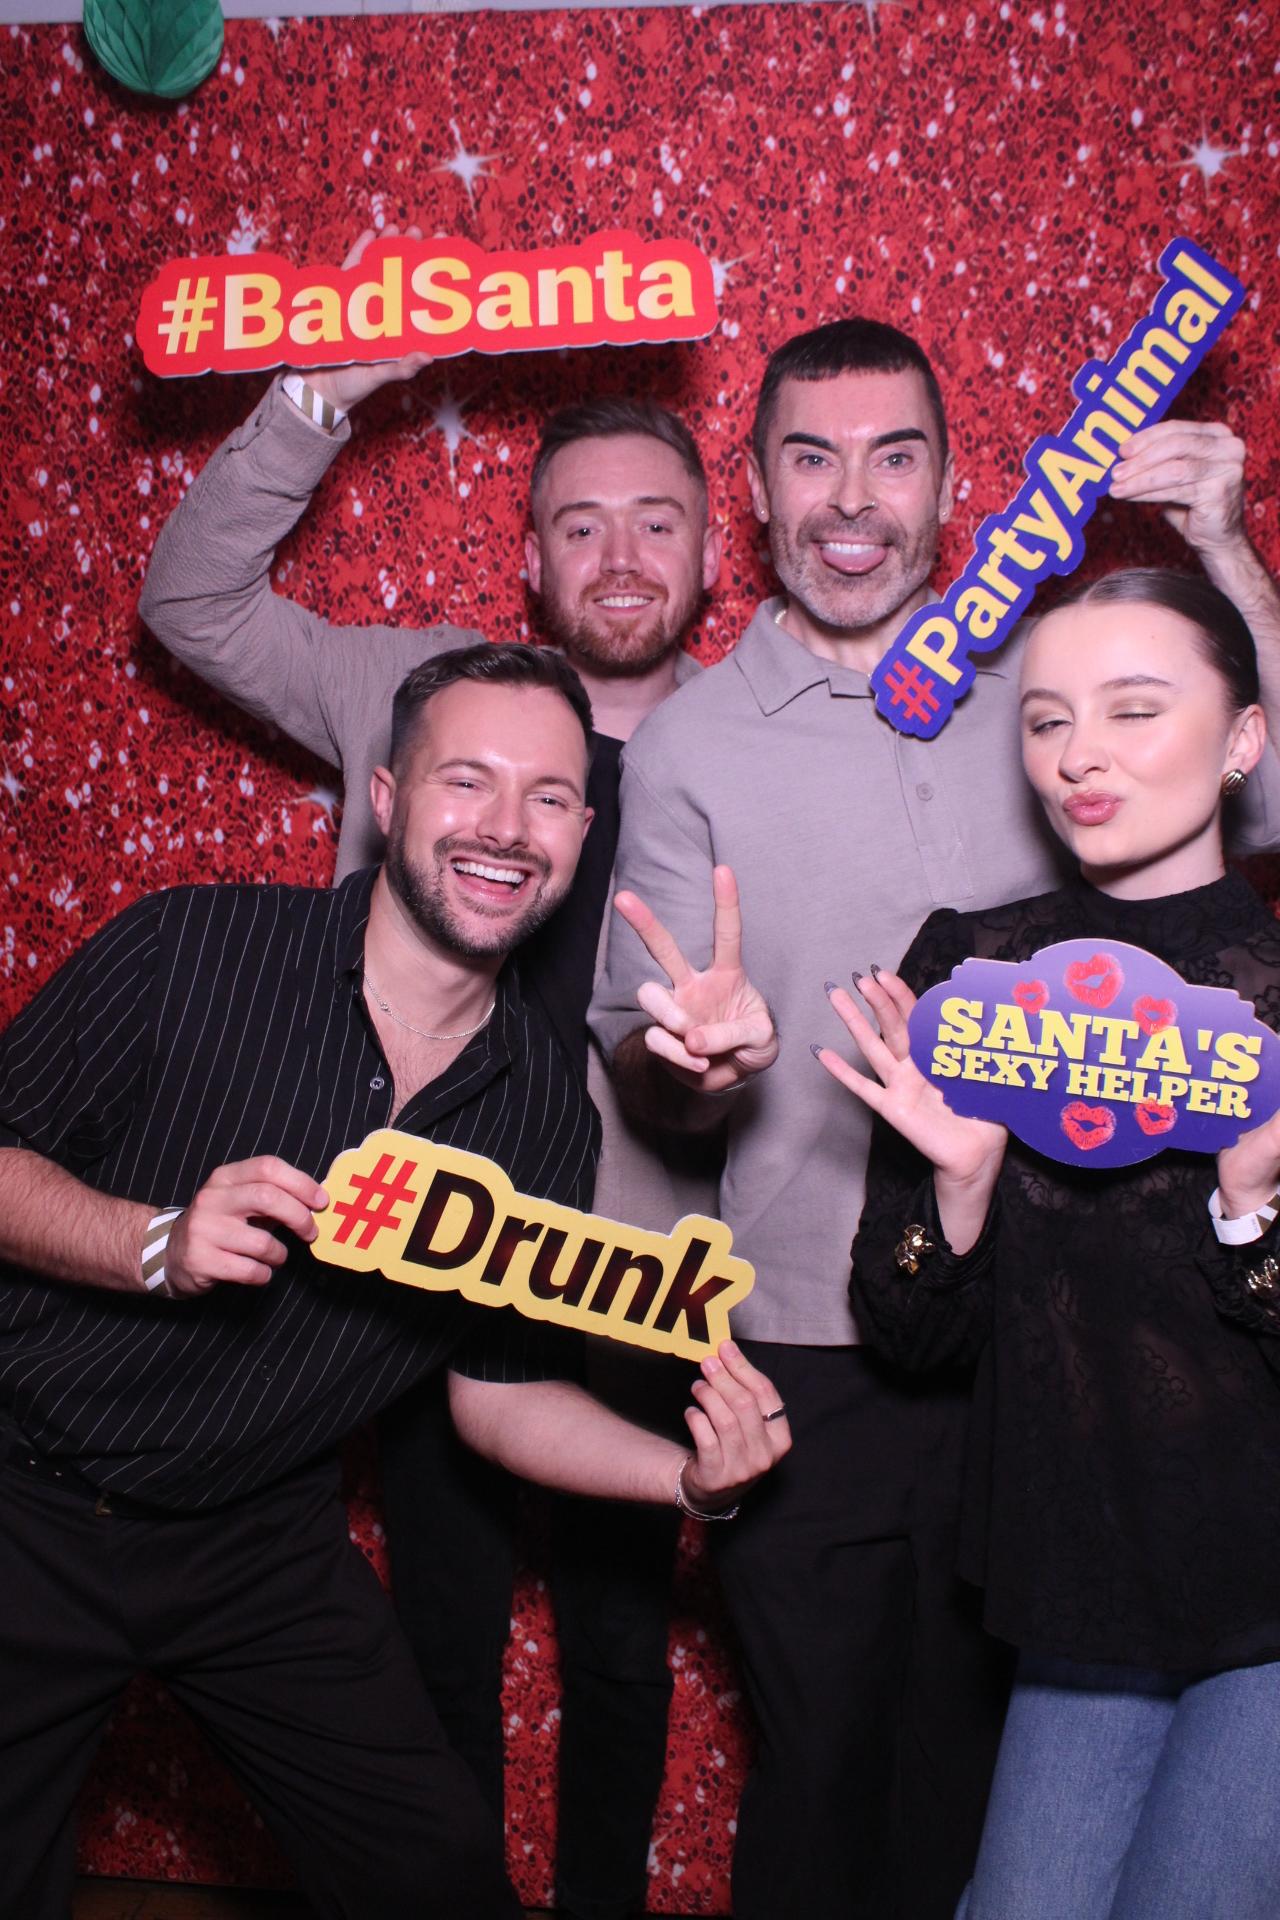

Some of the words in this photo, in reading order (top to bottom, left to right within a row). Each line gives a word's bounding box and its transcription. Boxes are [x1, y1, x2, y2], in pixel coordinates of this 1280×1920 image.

[158, 250, 696, 355] #BadSanta
[884, 251, 1233, 724] #PartyAnimal
[931, 1045, 1058, 1091] SEXY
[1066, 1063, 1251, 1119] HELPER
[938, 997, 1262, 1083] SANTA'S
[332, 1153, 735, 1344] #Drunk
